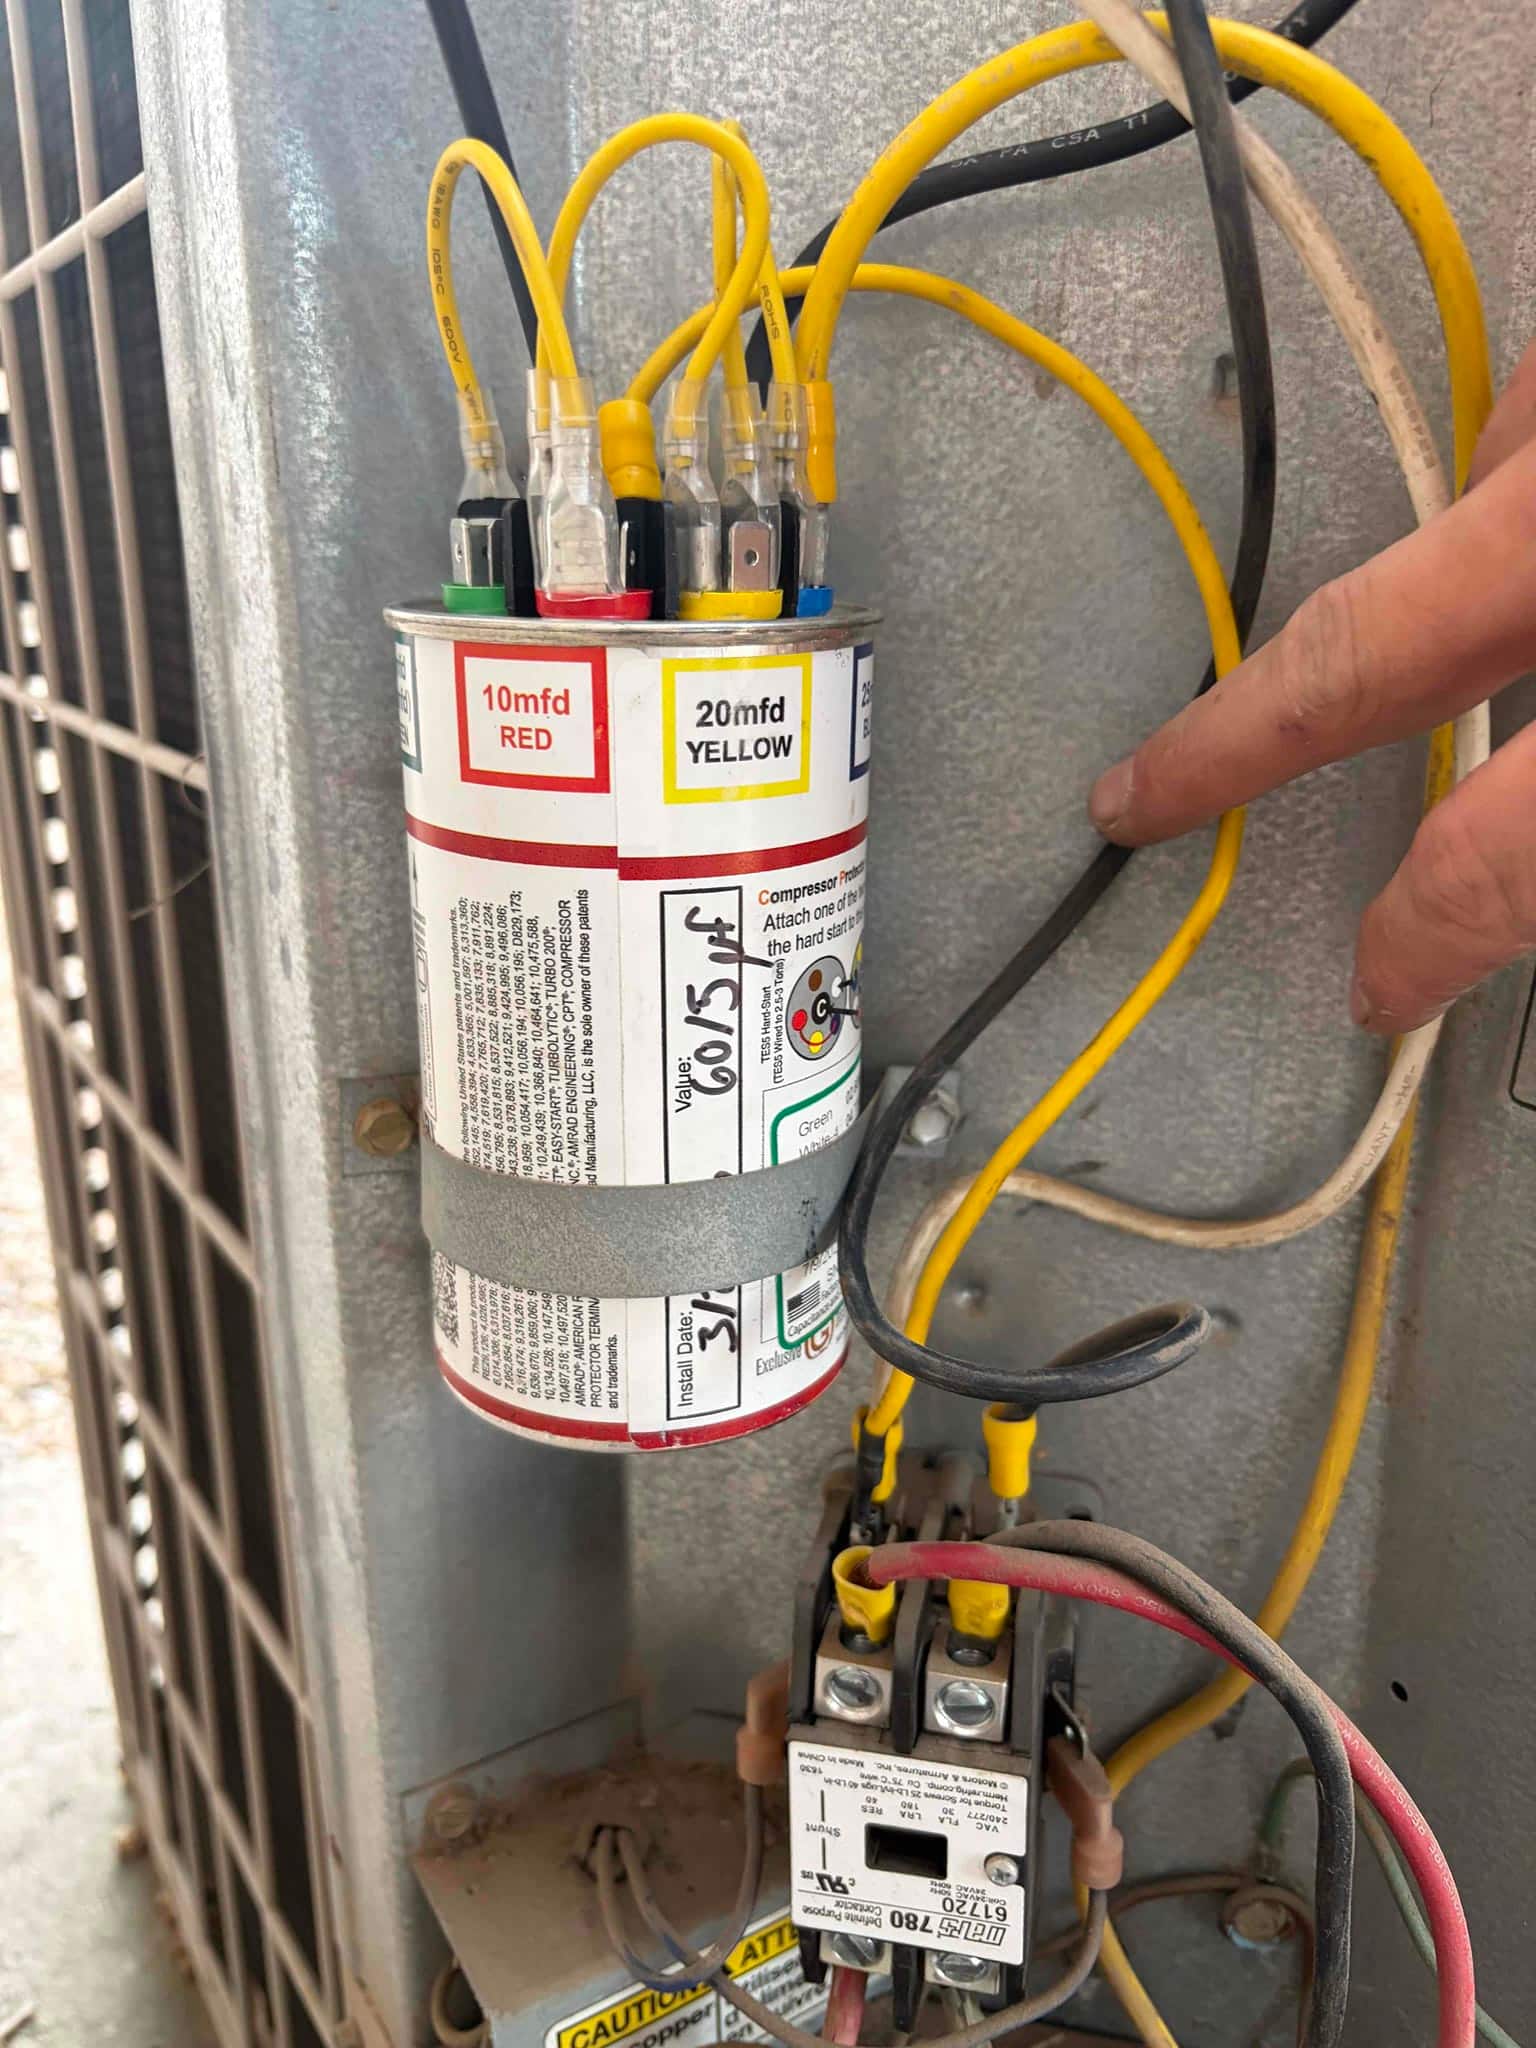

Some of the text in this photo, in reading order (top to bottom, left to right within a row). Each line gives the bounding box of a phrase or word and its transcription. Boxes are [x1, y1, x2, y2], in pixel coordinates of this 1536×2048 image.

[1050, 127, 1101, 150] CSA
[482, 683, 571, 717] 10mfd
[695, 696, 787, 729] 20mfd
[500, 725, 554, 751] RED
[686, 735, 793, 764] YELLOW
[758, 875, 838, 905] Compressor
[576, 889, 591, 930] patents
[763, 907, 811, 932] Attach
[814, 902, 835, 920] one
[837, 892, 846, 912] of
[449, 907, 460, 968] trademarks.
[558, 900, 573, 987] COMPRESSOR
[577, 933, 590, 962] these
[767, 938, 792, 957] the
[795, 926, 824, 951] hard
[826, 918, 847, 941] start
[452, 970, 461, 991] and
[544, 958, 558, 1000] TURBO
[578, 965, 590, 976] of
[581, 979, 592, 1012] owner
[454, 993, 464, 1031] patents
[580, 1015, 592, 1036] sole
[761, 986, 771, 1064] TES5 Hard-Start
[774, 1014, 783, 1024] to
[457, 1034, 466, 1065] States
[581, 1037, 594, 1055] the
[774, 1025, 783, 1054] Wired
[581, 1058, 593, 1067] is
[458, 1067, 467, 1100] United
[581, 1070, 595, 1094] LLC,
[674, 1056, 692, 1113] Value:
[460, 1102, 469, 1145] following
[566, 1116, 579, 1157] AMRAD
[583, 1097, 597, 1171] Manufacturing,
[799, 1109, 833, 1137] Green
[572, 1305, 585, 1360] AMERICAN
[605, 1334, 618, 1408] and trademarks.
[677, 1310, 693, 1408] Install Date:
[589, 1343, 602, 1408] PROTECTOR
[961, 1775, 997, 1788] Motors
[923, 1791, 957, 1805] Screws
[959, 1797, 972, 1807] for
[974, 1797, 1008, 1812] Torque
[805, 1823, 841, 1838] Shunt
[861, 1804, 1000, 1833] VAC FLA LRA RES
[801, 1905, 882, 1929] Definite Purpose
[834, 1900, 882, 1916] Contactor
[890, 1910, 933, 1934] 780
[941, 1896, 1008, 1922] 61720
